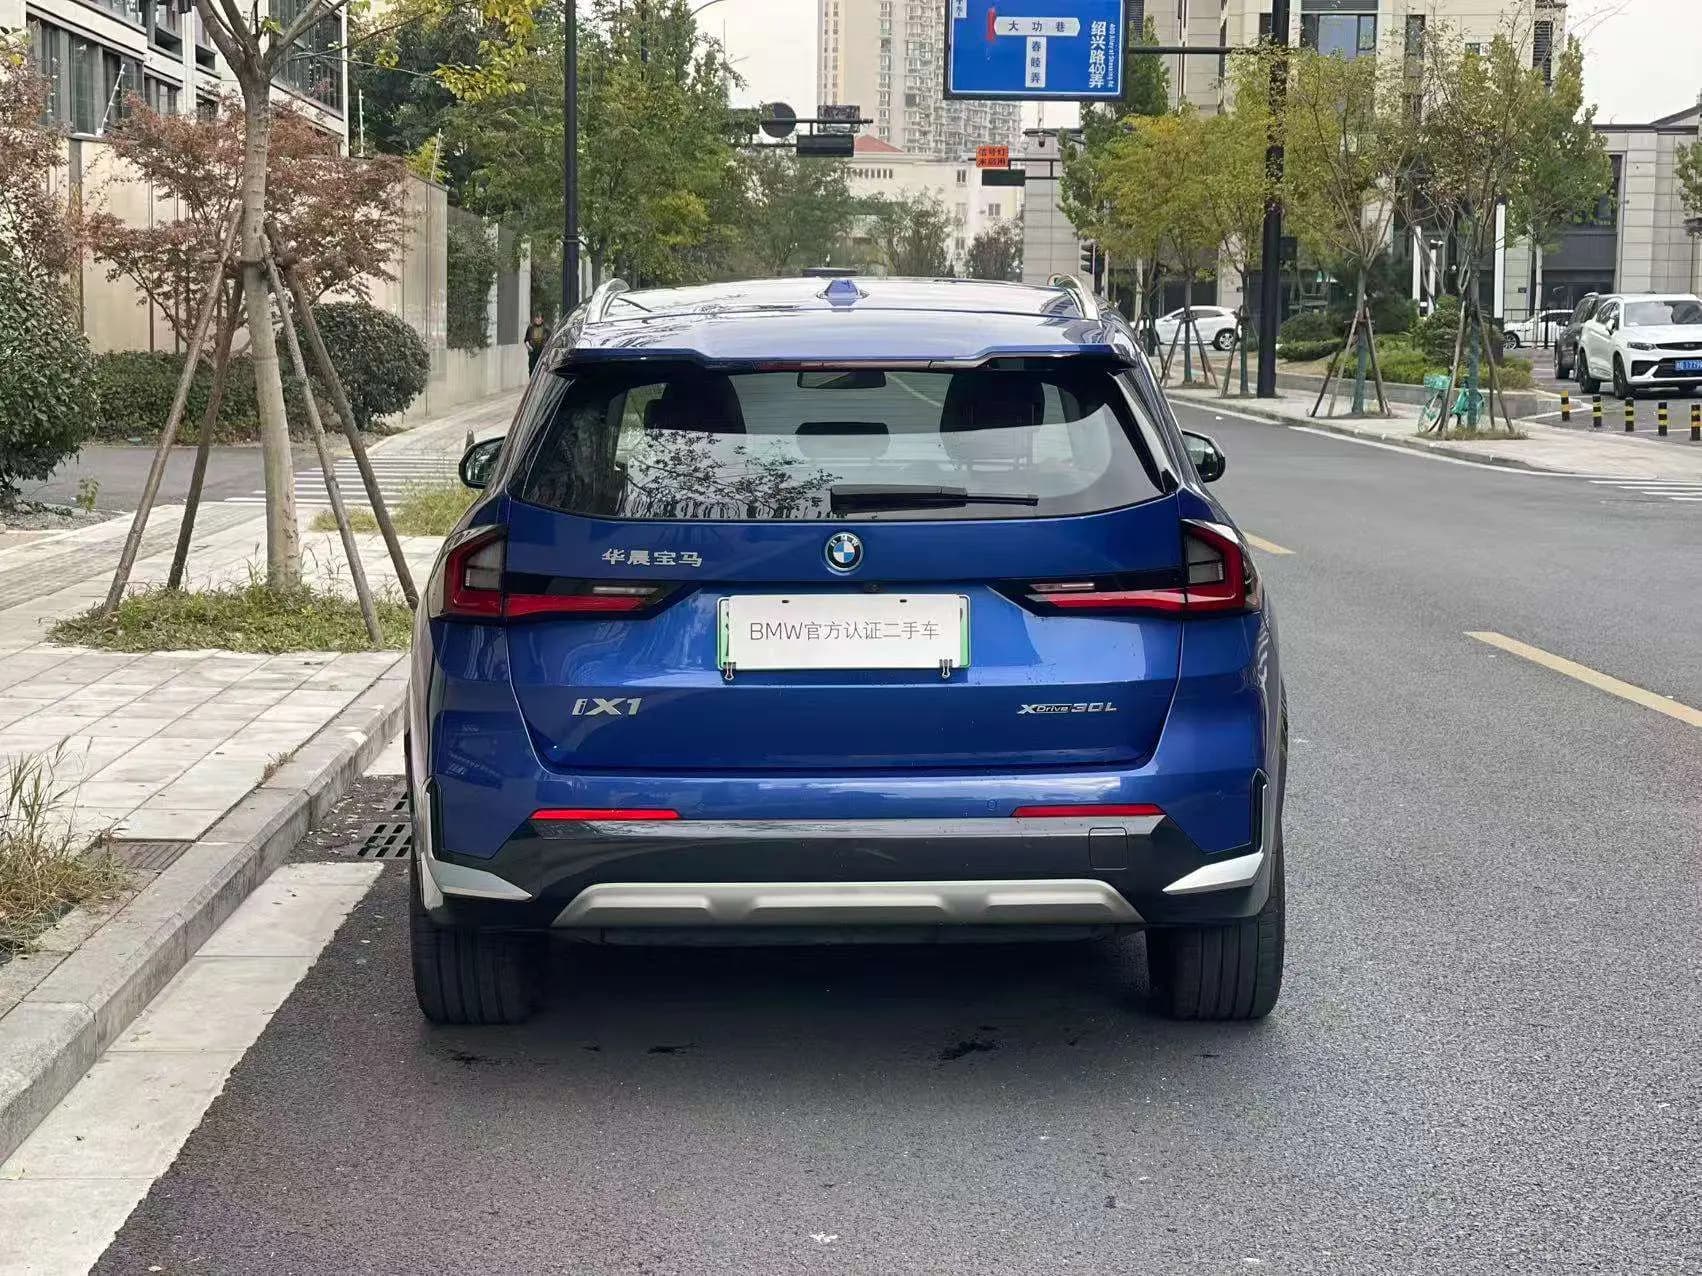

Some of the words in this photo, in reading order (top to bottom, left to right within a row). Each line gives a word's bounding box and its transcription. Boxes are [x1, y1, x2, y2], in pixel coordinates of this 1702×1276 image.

[1008, 20, 1065, 32] 大功巷
[1089, 21, 1106, 88] 绍兴路400弄
[1107, 55, 1115, 80] Shaoxing
[830, 534, 860, 547] BMW
[602, 548, 703, 568] 华晨宝马
[749, 621, 940, 641] BMW官方认证二手车
[572, 698, 642, 716] iX1
